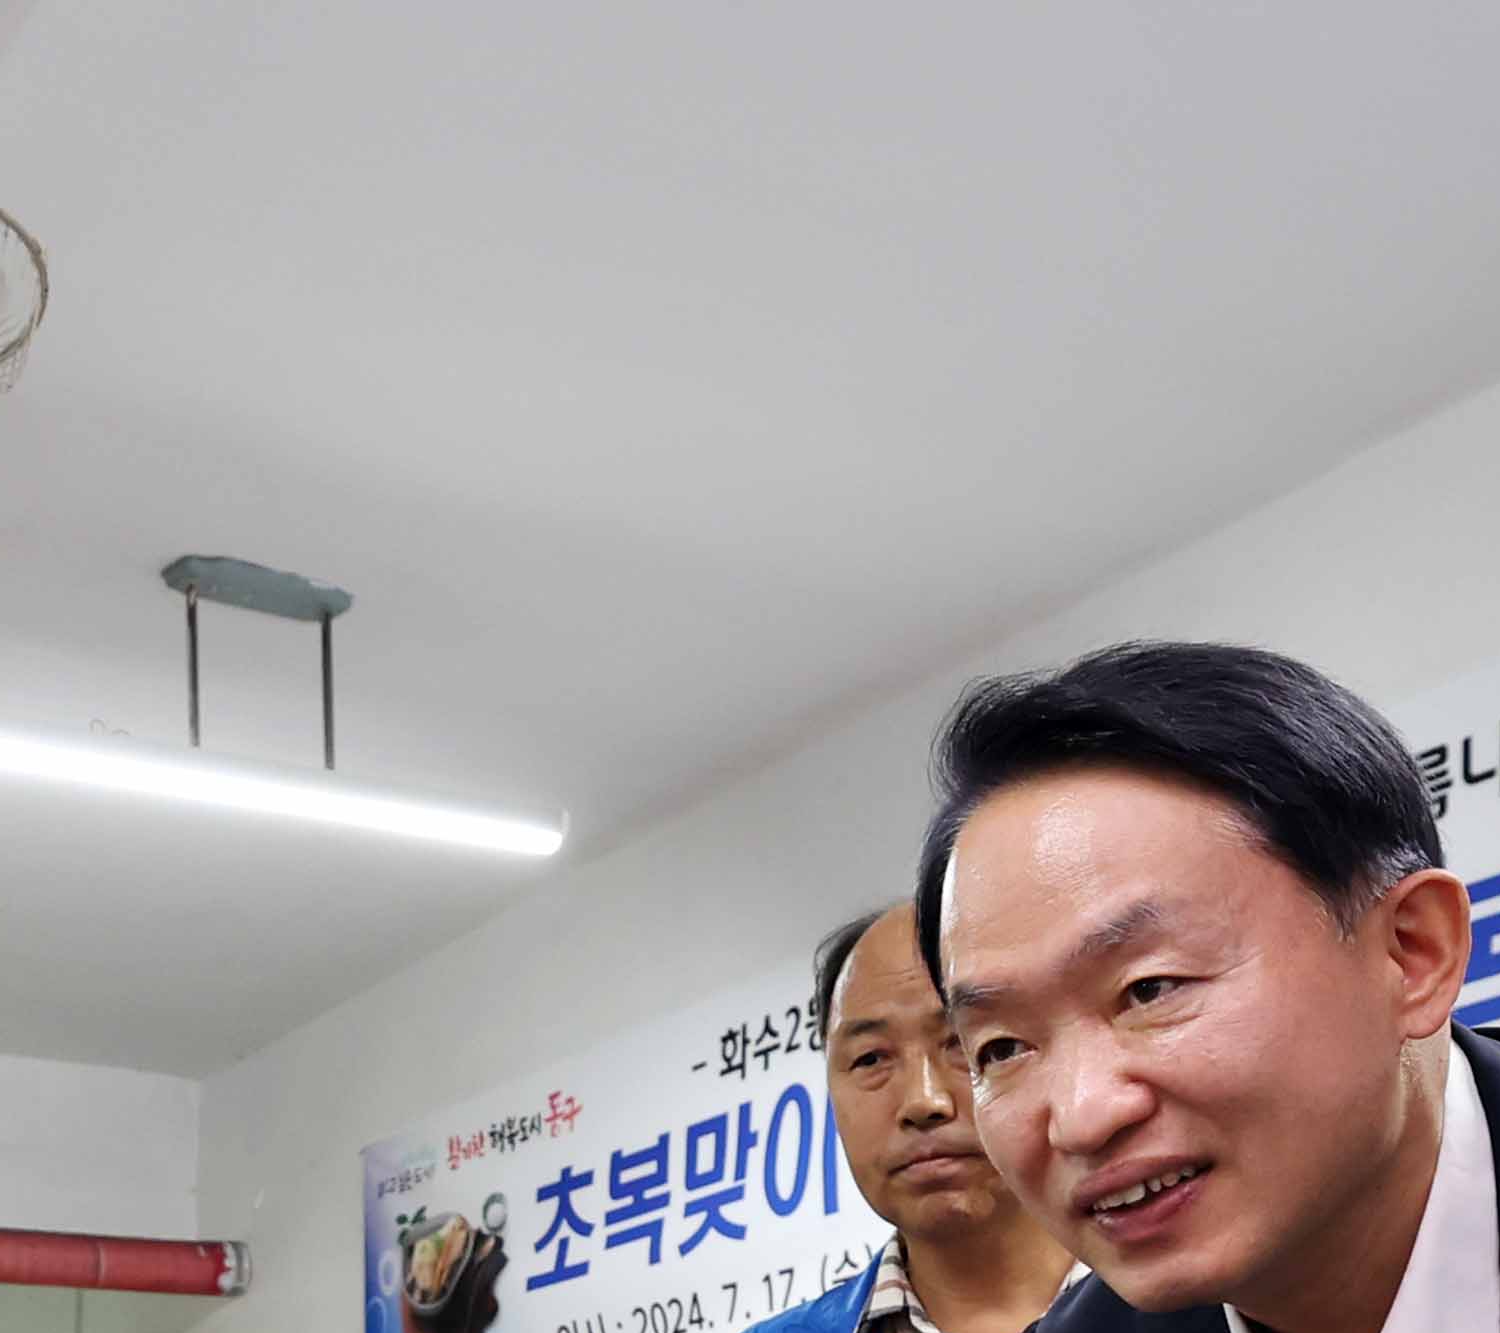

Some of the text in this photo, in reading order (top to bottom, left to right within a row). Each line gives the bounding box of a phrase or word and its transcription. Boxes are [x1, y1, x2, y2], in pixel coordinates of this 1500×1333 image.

[543, 1090, 585, 1138] 동구
[525, 1083, 839, 1292] 초복맞이
[722, 1281, 752, 1324] 7.
